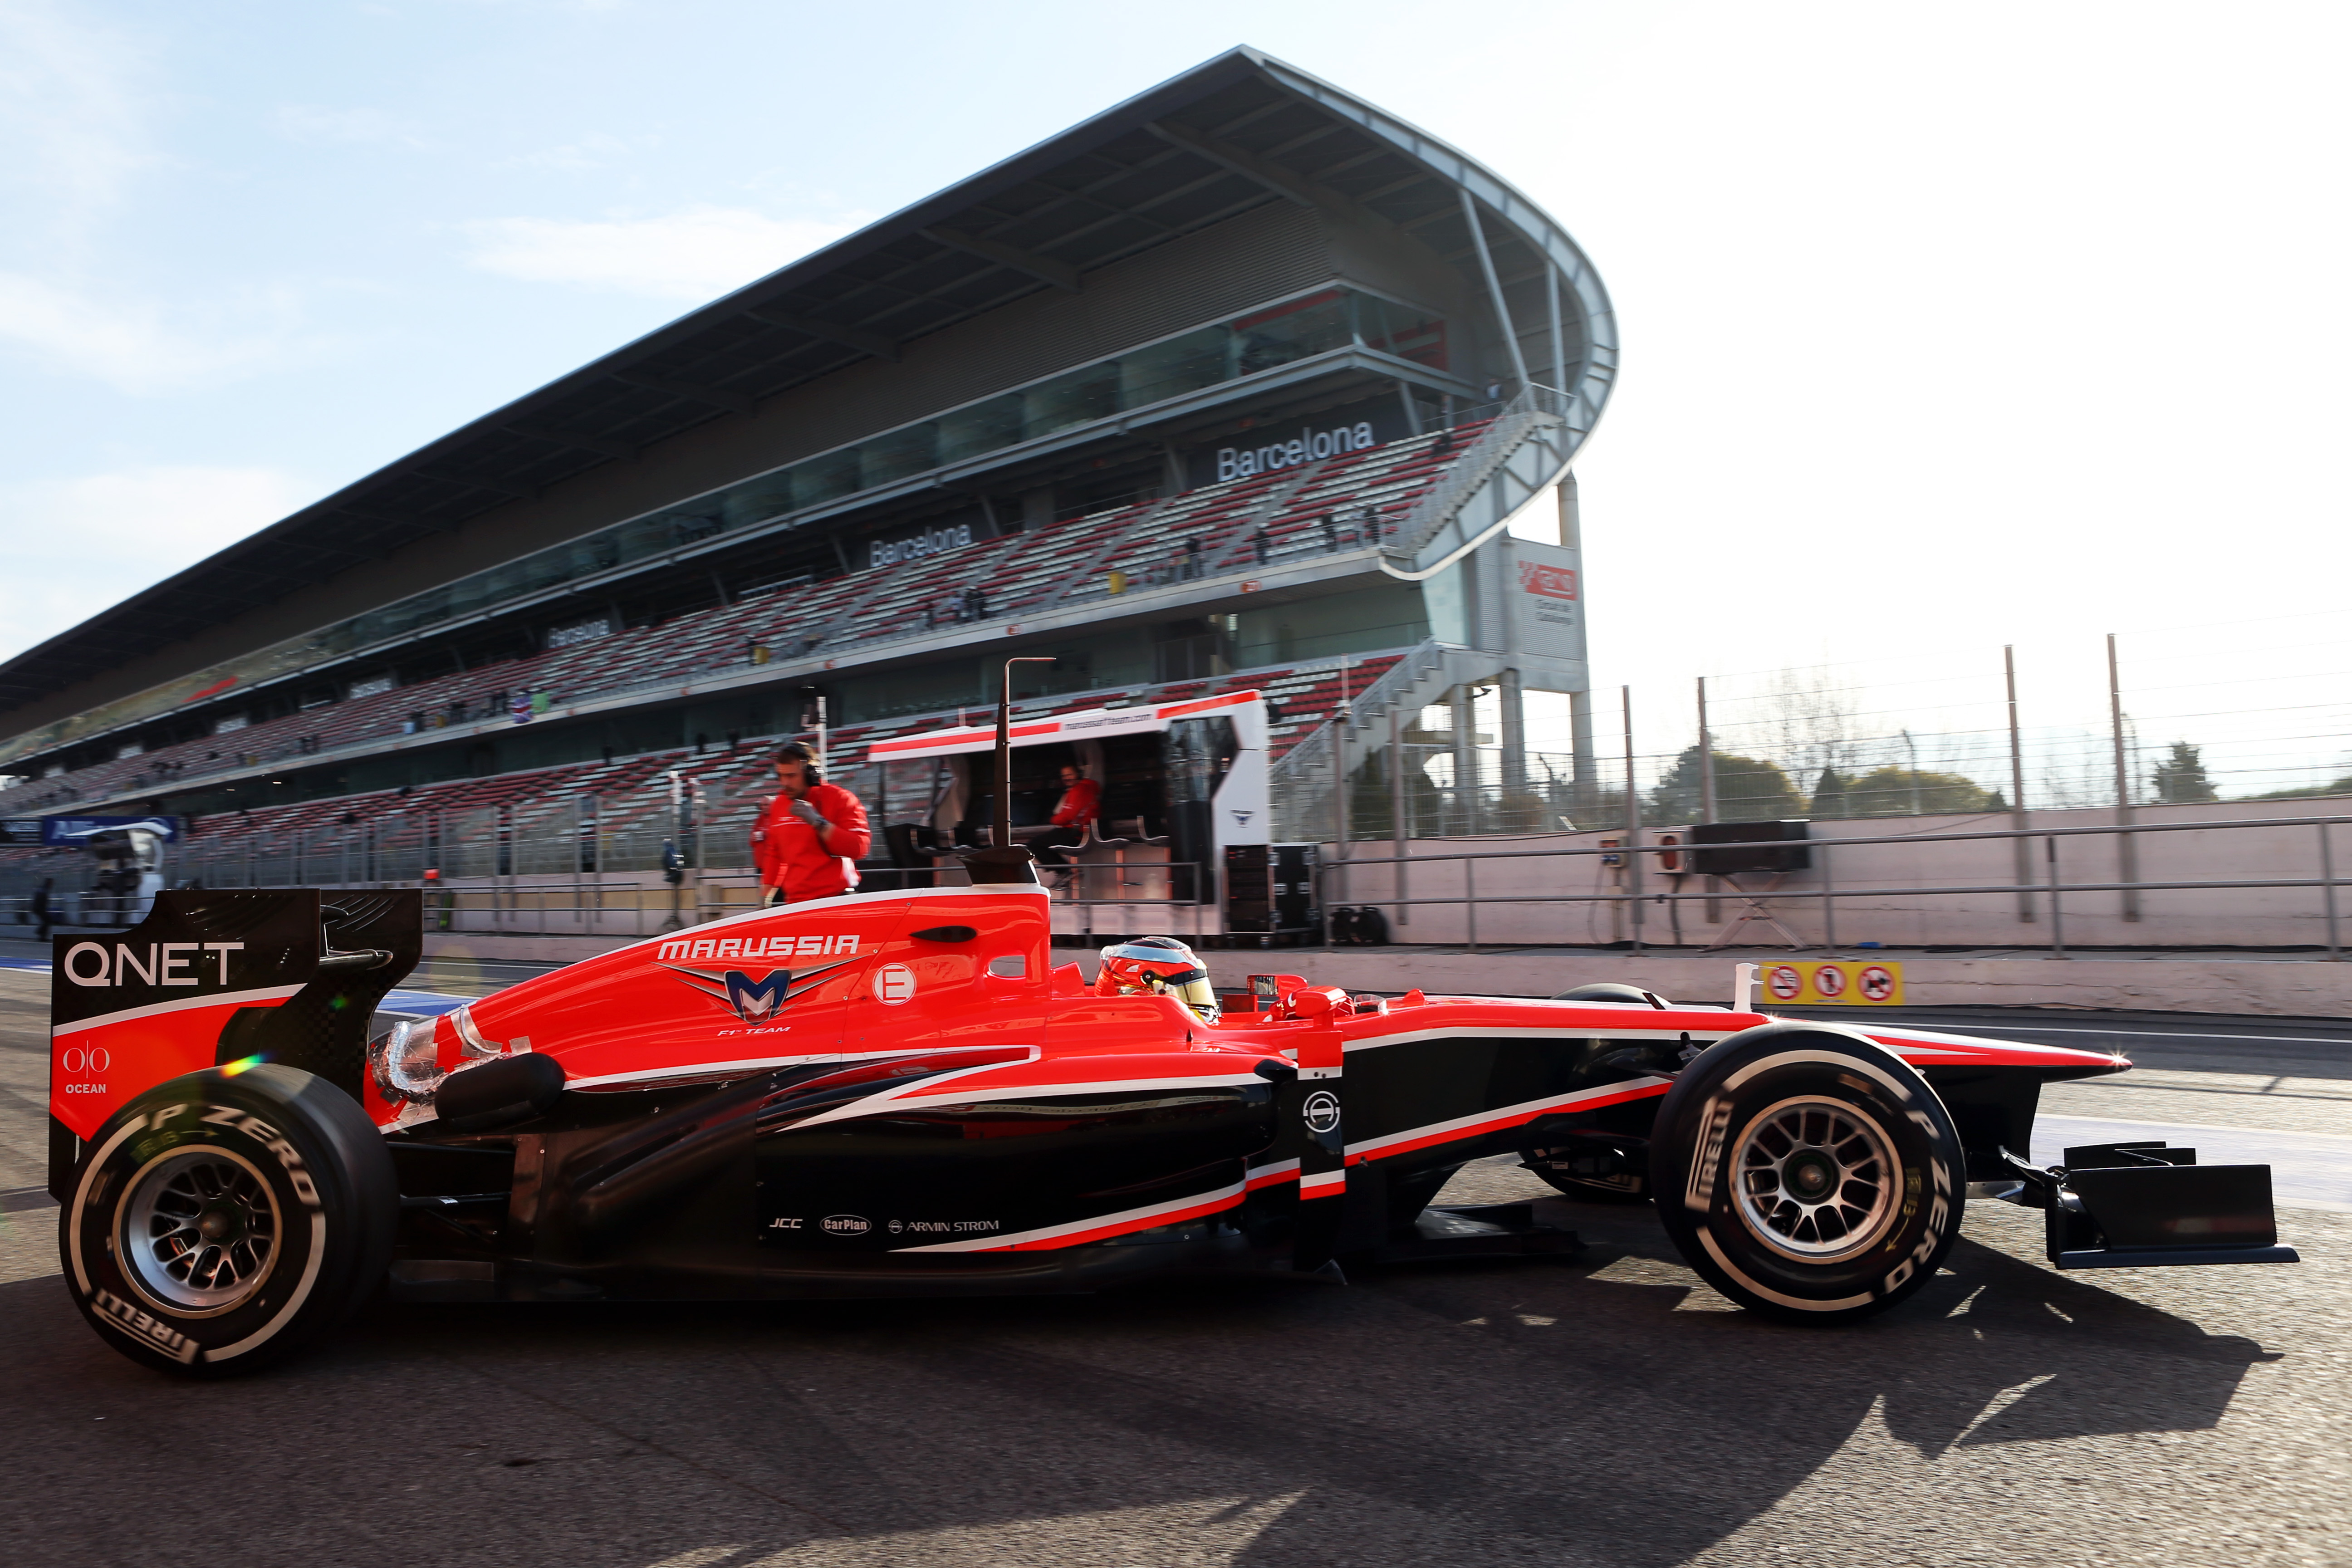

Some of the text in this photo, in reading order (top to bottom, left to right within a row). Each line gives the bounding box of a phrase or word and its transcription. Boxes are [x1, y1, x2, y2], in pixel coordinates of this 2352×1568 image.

[1217, 421, 1375, 482] Barcelona
[870, 524, 972, 567] Barcelona
[64, 942, 244, 986] QNET
[657, 935, 860, 959] MARUSSIA
[65, 1084, 106, 1093] OCEAN
[150, 1103, 188, 1131] P
[200, 1104, 322, 1206] ZERO
[1685, 1096, 1735, 1213] PIRELLI
[769, 1218, 803, 1228] JCC
[1884, 1110, 1951, 1294] P ZERO
[824, 1219, 867, 1230] CarPlan
[907, 1220, 999, 1231] ARMIN STROM
[91, 1288, 200, 1365] PIRELLI
